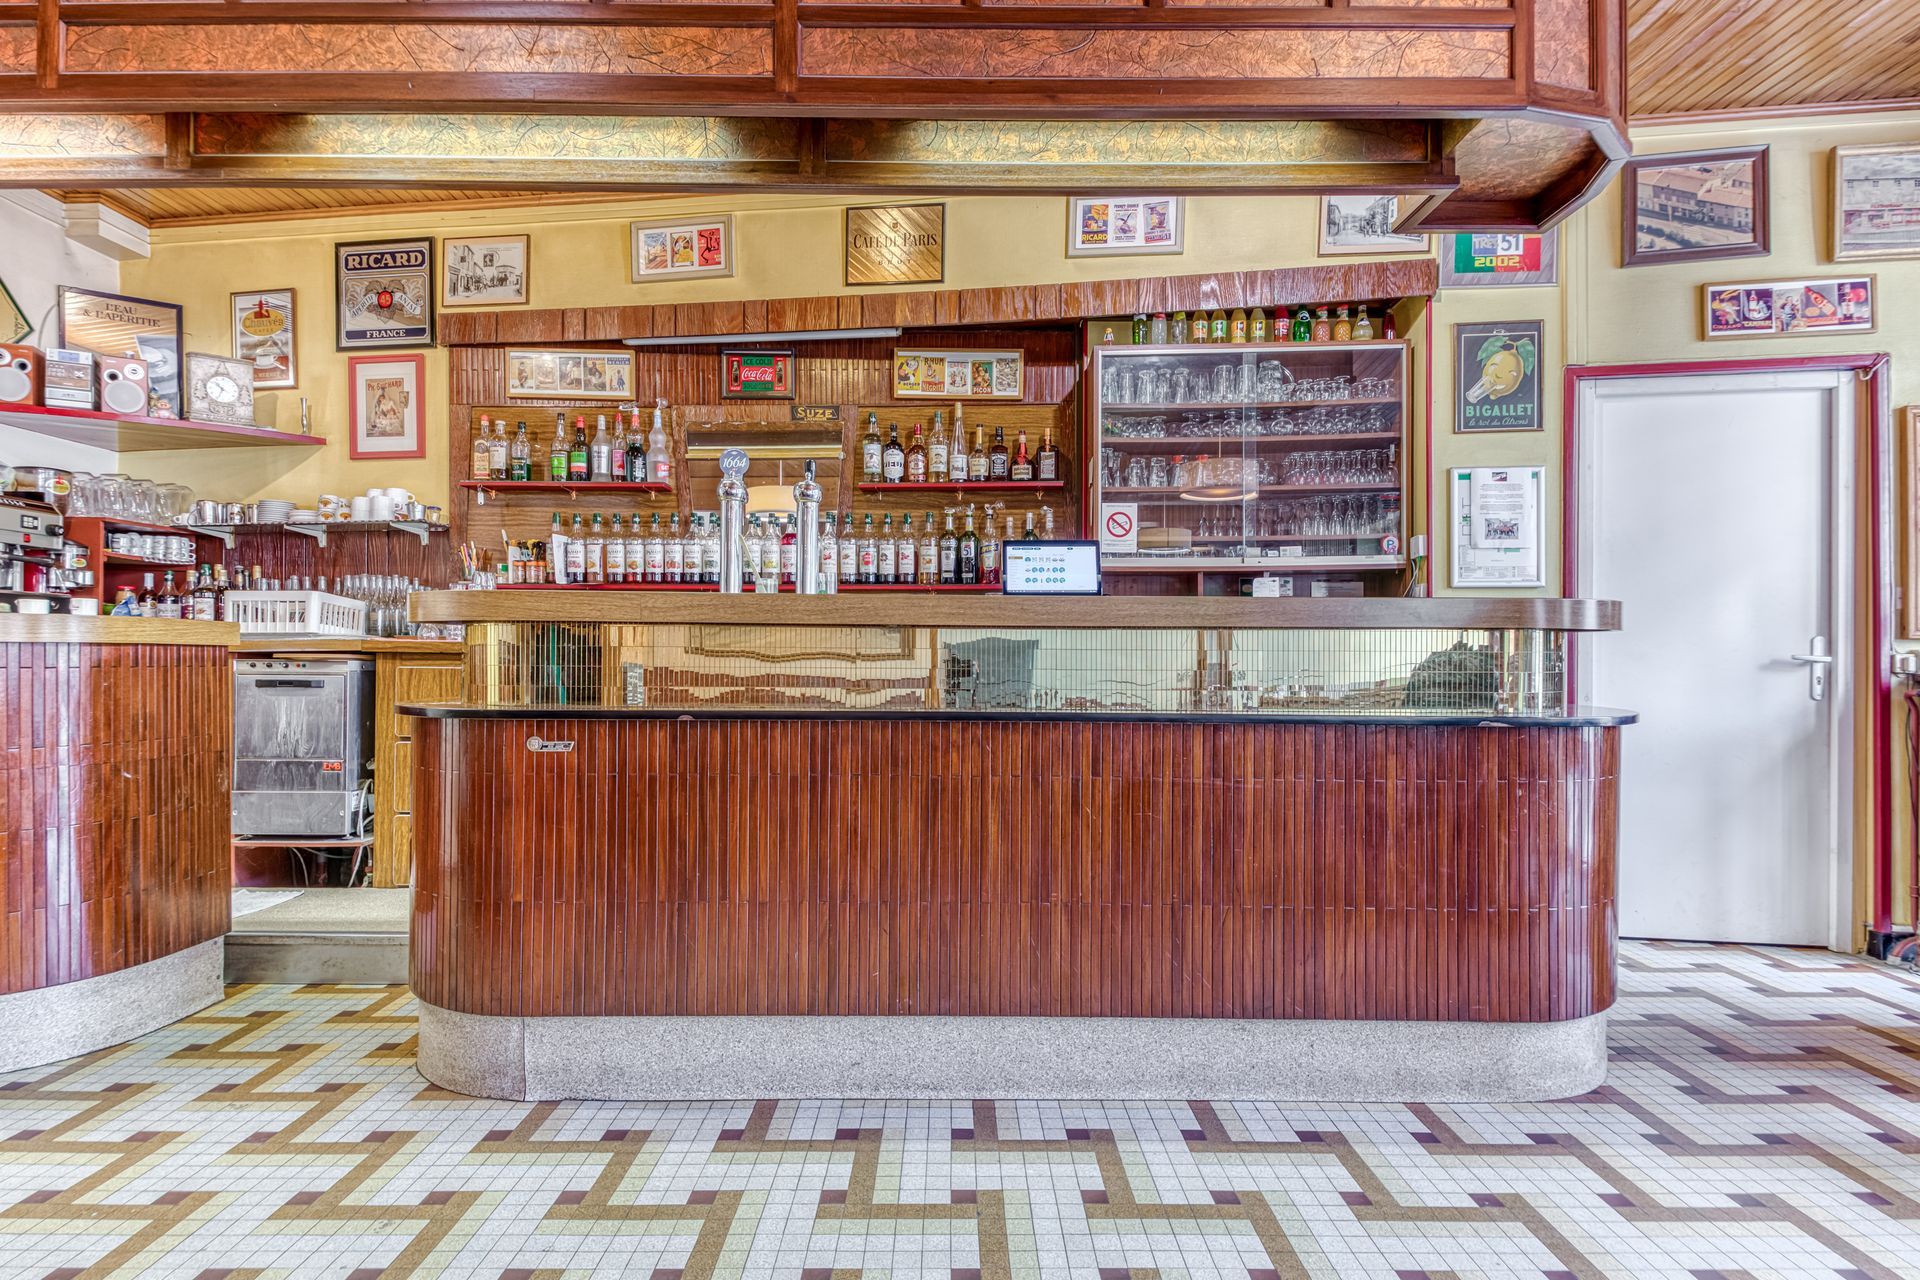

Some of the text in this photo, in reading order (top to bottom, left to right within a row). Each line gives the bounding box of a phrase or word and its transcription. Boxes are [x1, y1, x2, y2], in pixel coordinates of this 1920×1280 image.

[903, 232, 937, 247] PARIS
[1081, 233, 1109, 241] RICARD
[347, 252, 423, 269] RICARD
[1474, 256, 1520, 267] 2002
[381, 295, 391, 305] 45
[82, 308, 91, 317] &
[366, 329, 406, 338] FRANCE
[743, 356, 753, 365] ICE
[924, 357, 944, 366] RHUM
[797, 406, 833, 418] SUZE
[1465, 403, 1534, 417] BIGALLET
[722, 456, 746, 468] 1664
[963, 546, 972, 556] 51
